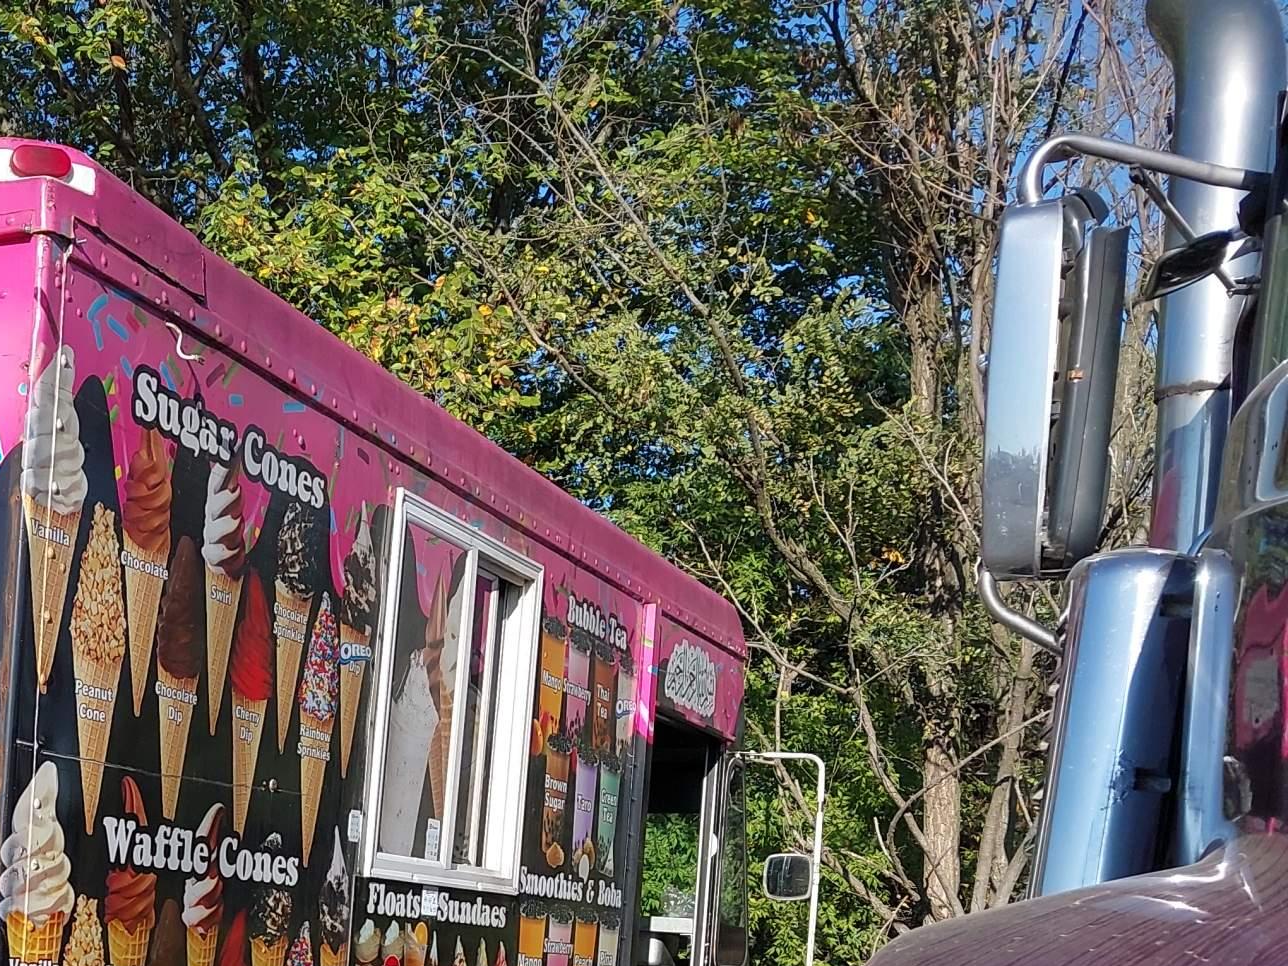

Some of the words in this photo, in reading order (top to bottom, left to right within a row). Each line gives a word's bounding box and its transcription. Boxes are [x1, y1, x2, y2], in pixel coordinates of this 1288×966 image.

[135, 371, 235, 462] Sugar
[244, 430, 326, 509] Cones
[31, 518, 71, 546] Vanilla
[120, 550, 169, 580] Chocolate
[211, 585, 233, 605] Swirl
[274, 602, 307, 624] Chocolate
[567, 595, 605, 639] Bubble
[609, 617, 627, 650] Tea
[273, 622, 306, 644] Sprinkles
[340, 643, 372, 660] OREO
[349, 661, 361, 676] Dip
[75, 679, 113, 701] Peanut
[542, 669, 562, 692] Mango
[563, 677, 592, 706] Strawberry
[155, 681, 198, 706] Chocolate
[597, 684, 610, 702] Thai
[79, 704, 106, 723] Cone
[167, 706, 183, 727] Dip
[235, 705, 261, 727] Cherry
[596, 702, 608, 719] Tea
[616, 699, 637, 714] OREO
[240, 727, 253, 745] Dip
[300, 724, 330, 743] Rainbow
[297, 742, 330, 762] Sprinkles
[544, 773, 568, 793] Brown
[544, 790, 566, 812] Sugar
[577, 793, 592, 812] Taro
[103, 816, 209, 875] Waffle
[219, 836, 299, 886] Cones
[519, 866, 584, 902] Smoothies
[586, 879, 595, 903] &
[597, 879, 622, 909] Boba
[367, 882, 420, 919] Floats
[437, 892, 507, 928] Sundaes
[544, 939, 573, 958] Strawberry
